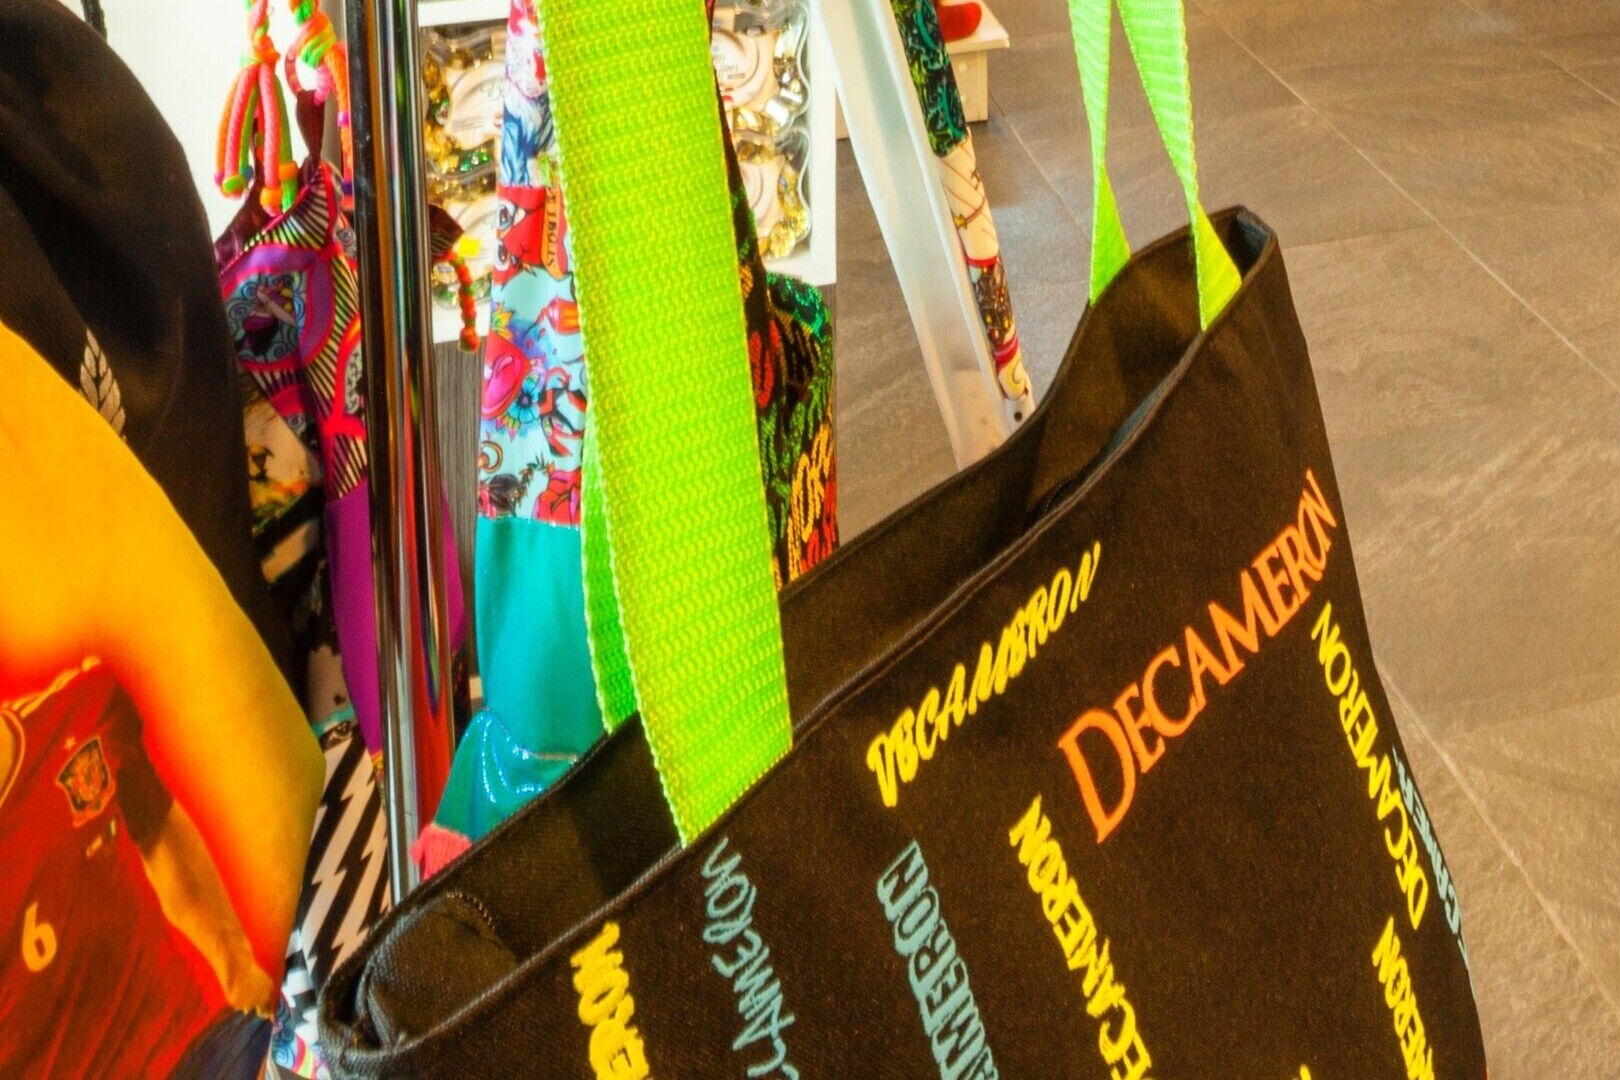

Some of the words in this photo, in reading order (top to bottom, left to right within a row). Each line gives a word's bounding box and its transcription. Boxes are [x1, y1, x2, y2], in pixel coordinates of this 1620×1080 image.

[1058, 469, 1337, 844] DECAMERON
[1311, 601, 1429, 930] DECAMERON
[22, 901, 58, 973] 6
[701, 836, 800, 1080] CAMERON
